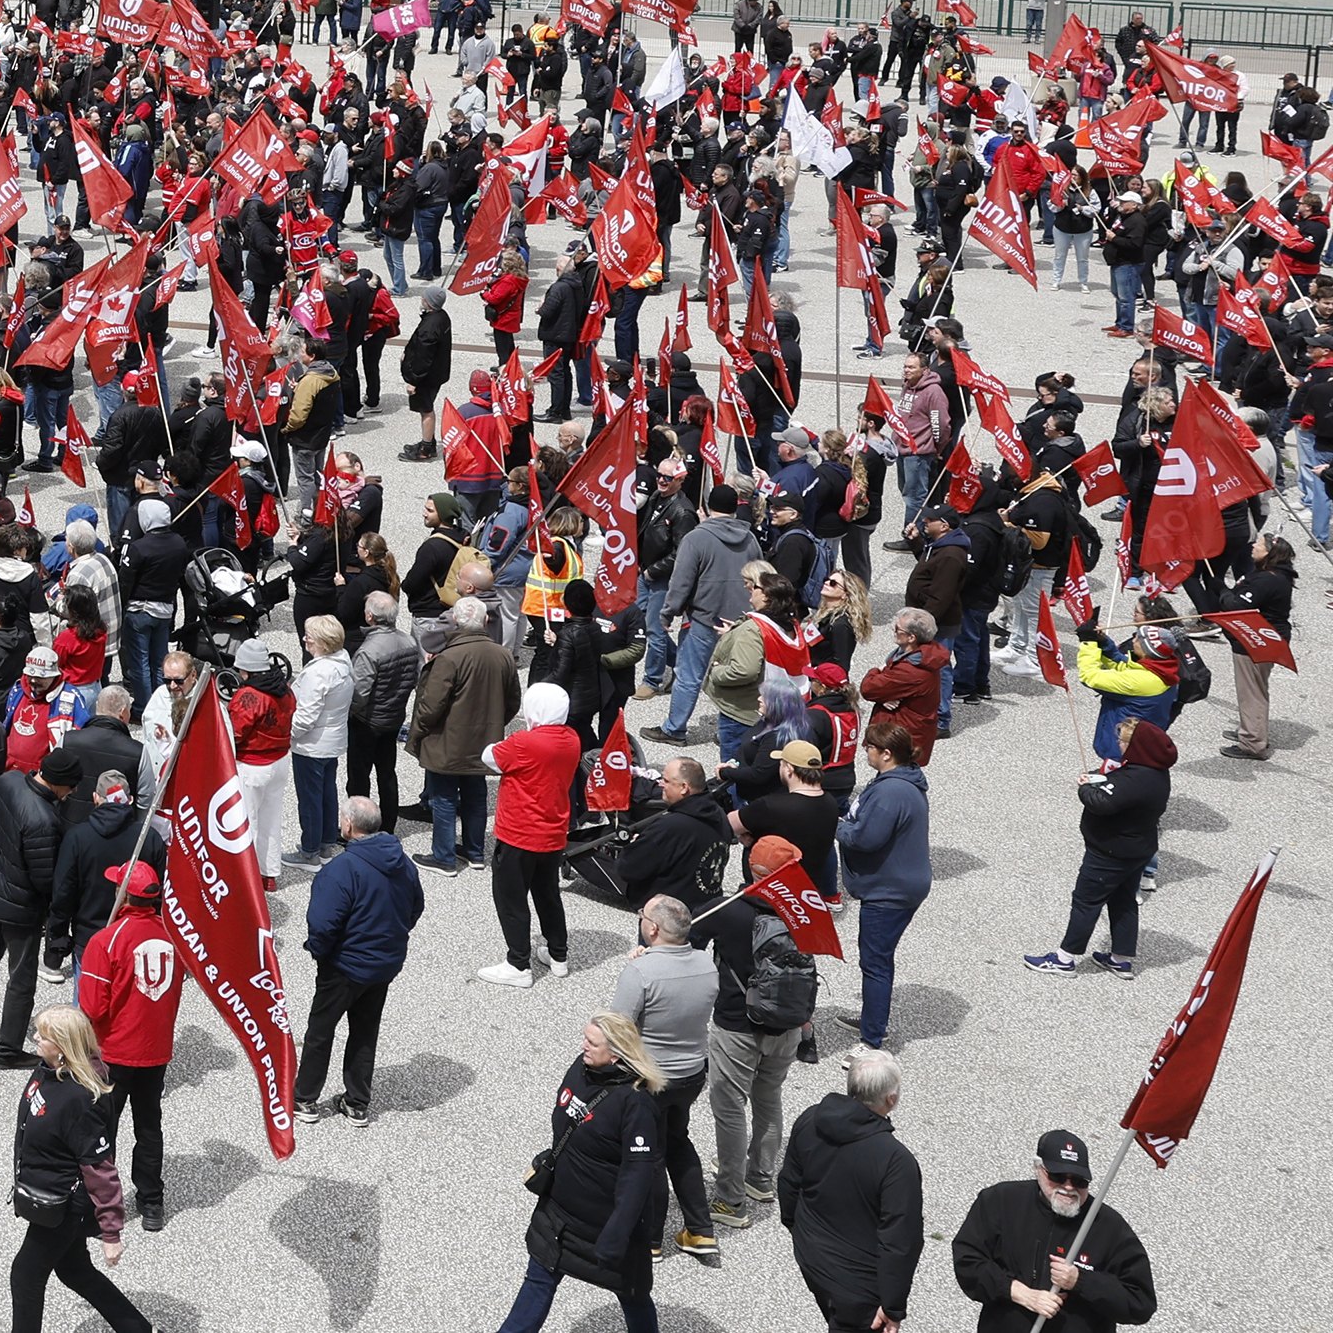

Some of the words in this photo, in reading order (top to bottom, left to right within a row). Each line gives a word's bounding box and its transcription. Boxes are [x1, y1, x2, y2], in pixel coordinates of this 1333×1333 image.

[399, 4, 415, 25] 543
[569, 2, 602, 22] UNIFOR
[102, 15, 148, 36] UNIFOR
[971, 216, 993, 238] Union
[1258, 214, 1288, 236] UNIFOR
[609, 214, 629, 263] UNIFOR
[1163, 330, 1204, 353] UNIFOR
[178, 793, 230, 903] UNIFOR
[768, 879, 812, 925] UNIFOR
[205, 965, 216, 983] &
[218, 980, 266, 1053] UNION
[262, 1053, 291, 1132] PROUD
